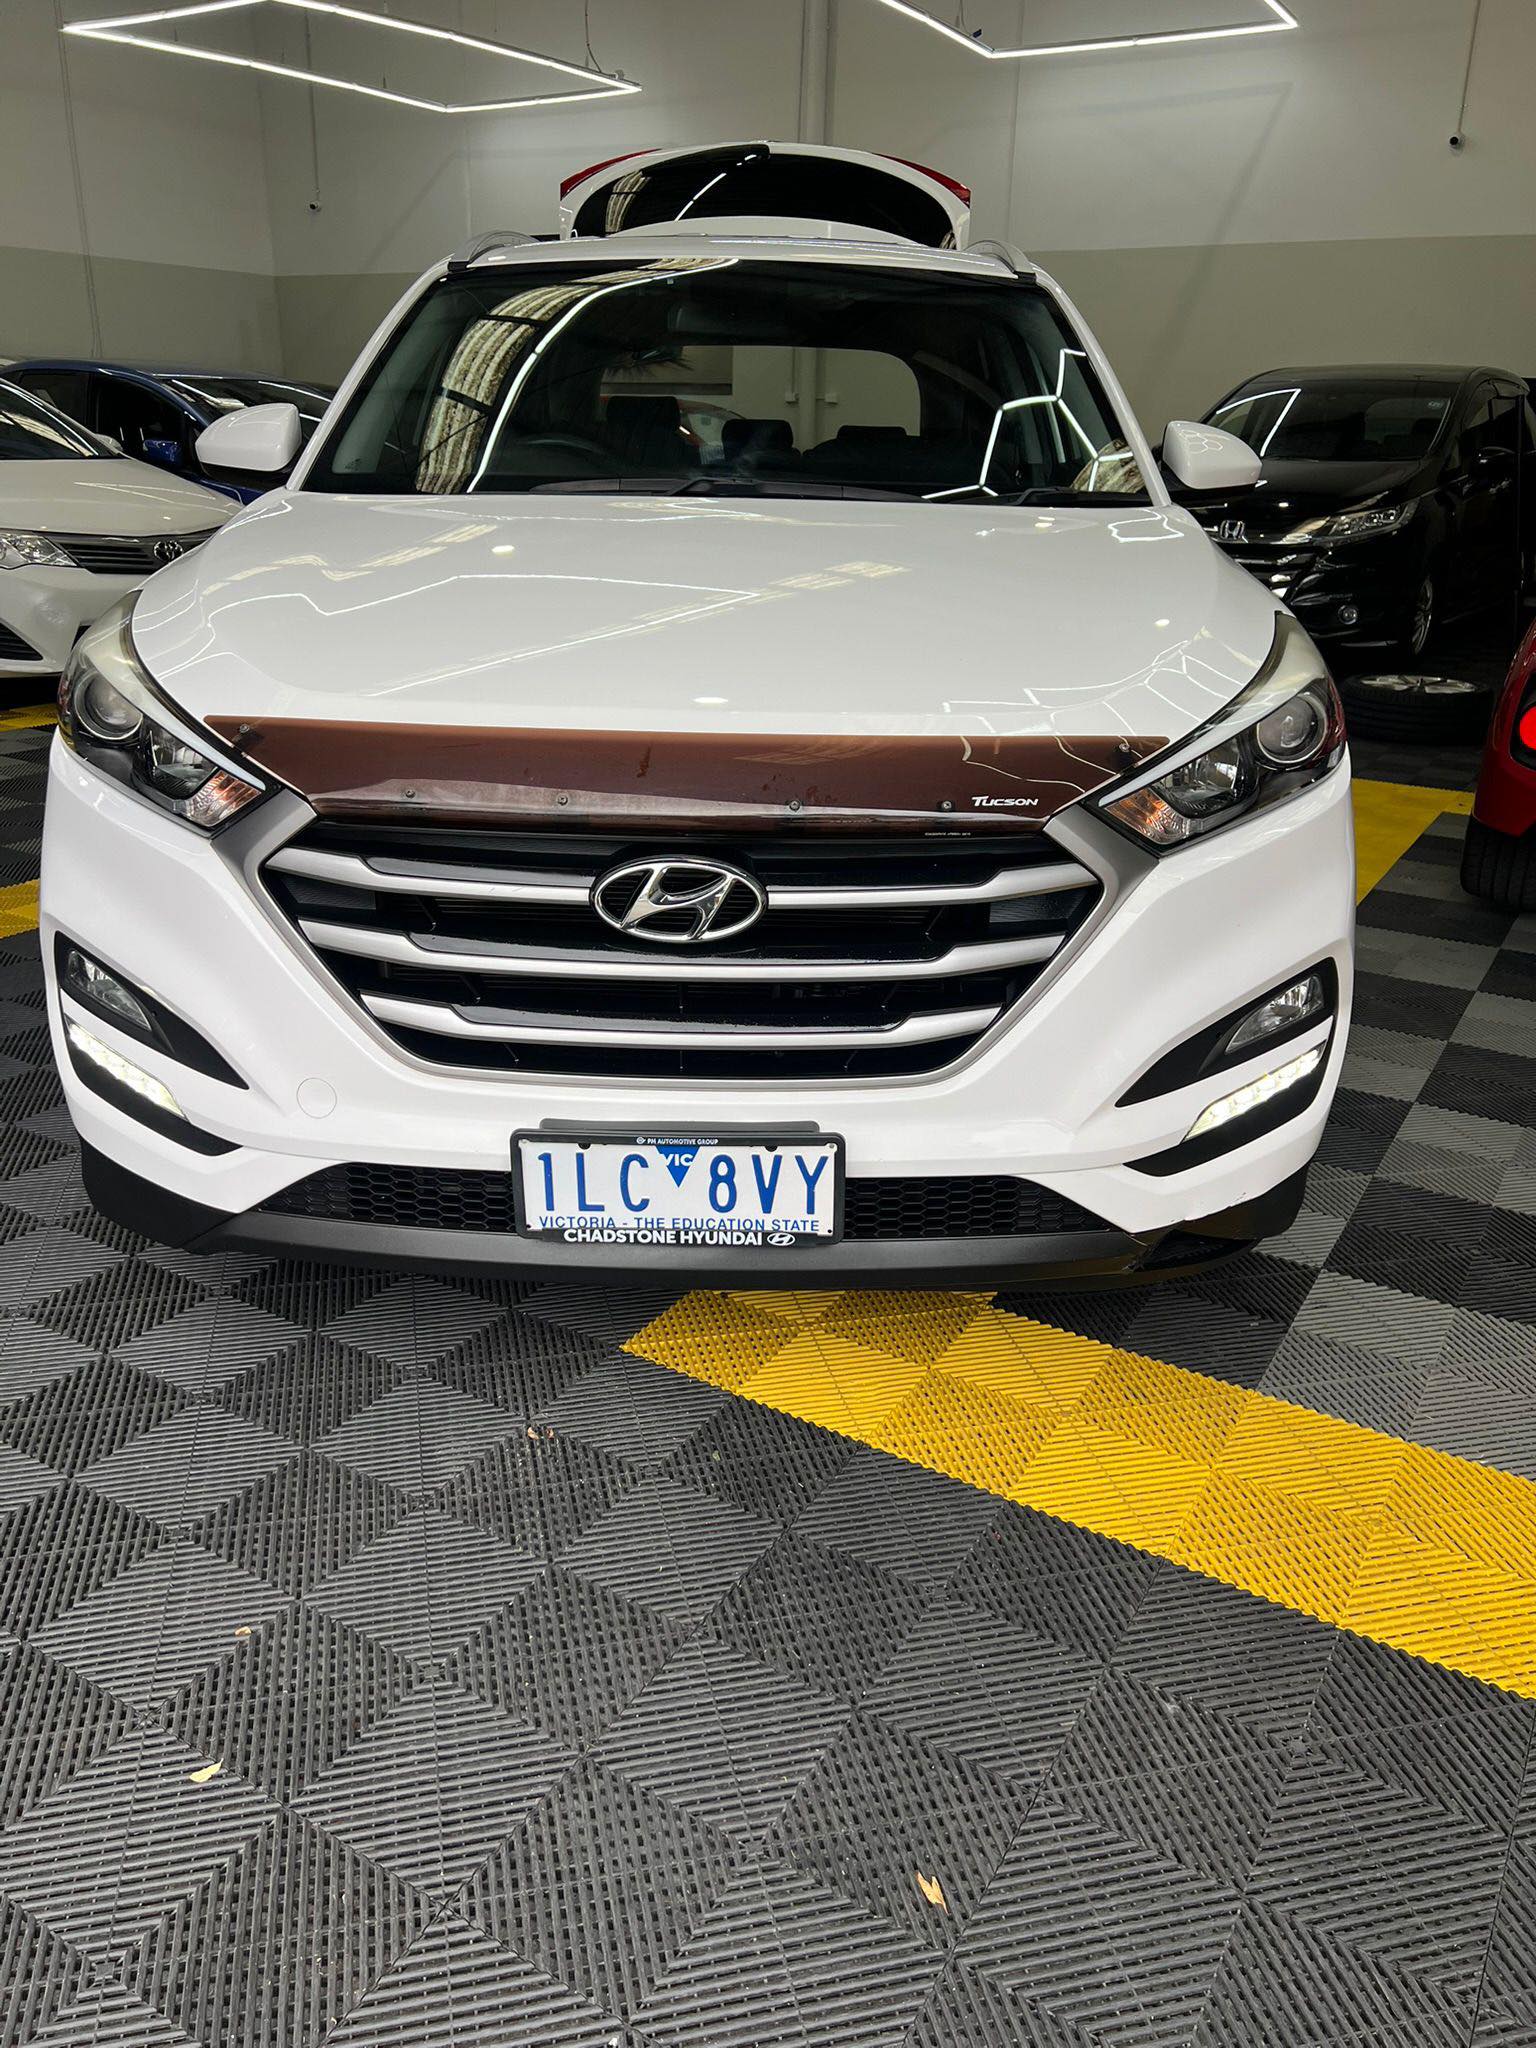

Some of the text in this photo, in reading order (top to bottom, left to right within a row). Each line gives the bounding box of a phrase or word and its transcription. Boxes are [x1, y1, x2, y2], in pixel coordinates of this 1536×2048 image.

[971, 795, 1039, 807] TUCSON
[663, 1153, 694, 1167] VIC
[537, 1151, 829, 1215] 1LC 8VY
[538, 1216, 616, 1231] VICTORIA
[633, 1217, 665, 1231] THE
[671, 1218, 768, 1232] EDUCATION
[771, 1219, 820, 1232] STATE
[563, 1228, 762, 1246] CHADSTONE HYUNDAI
